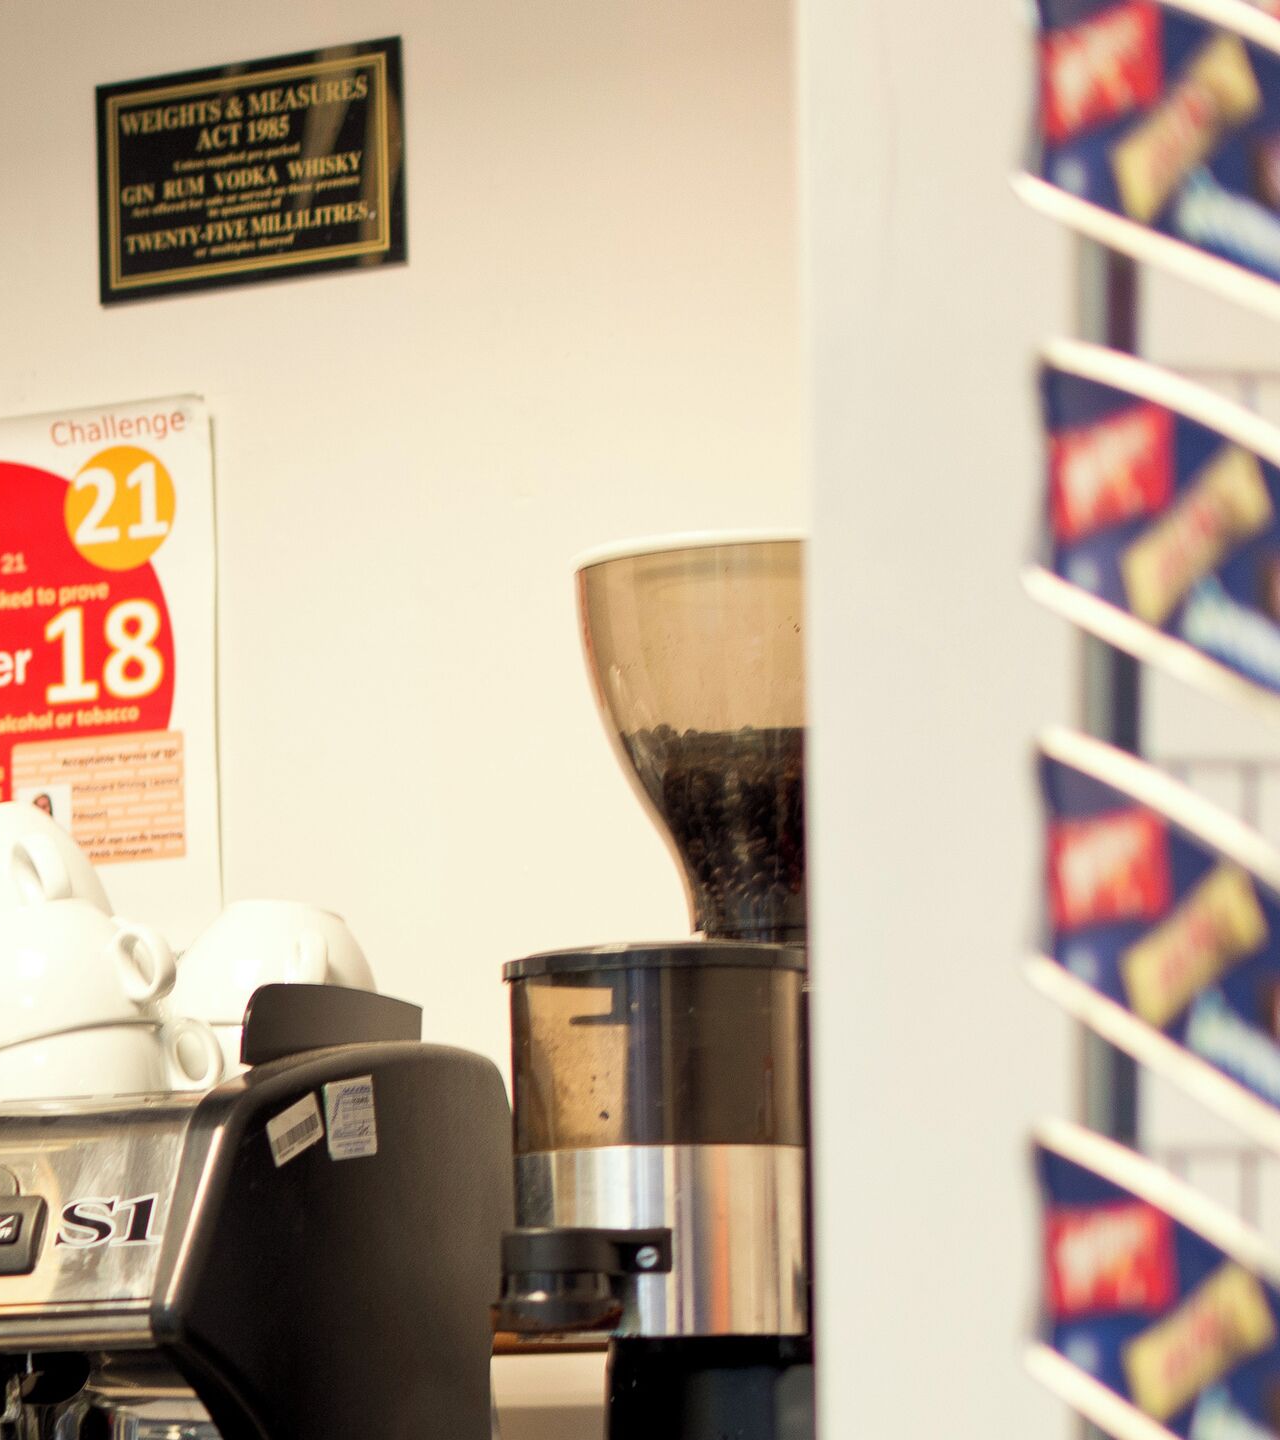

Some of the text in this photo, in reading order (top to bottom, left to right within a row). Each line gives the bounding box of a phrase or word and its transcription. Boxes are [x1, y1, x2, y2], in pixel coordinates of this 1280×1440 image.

[121, 75, 369, 135] WEIGHTS & MEASURES
[196, 114, 290, 152] ACT 1985
[121, 150, 362, 206] GIN RUM VODKA WHISKY
[125, 220, 249, 255] TWENTY-FIVE
[49, 409, 186, 447] Challenge
[72, 461, 168, 546] 21
[0, 552, 27, 575] 21
[36, 586, 56, 606] to
[58, 581, 110, 607] prove
[44, 598, 164, 705] 18
[55, 709, 74, 728] or
[76, 705, 140, 728] tobacco
[55, 1191, 162, 1250] S1
